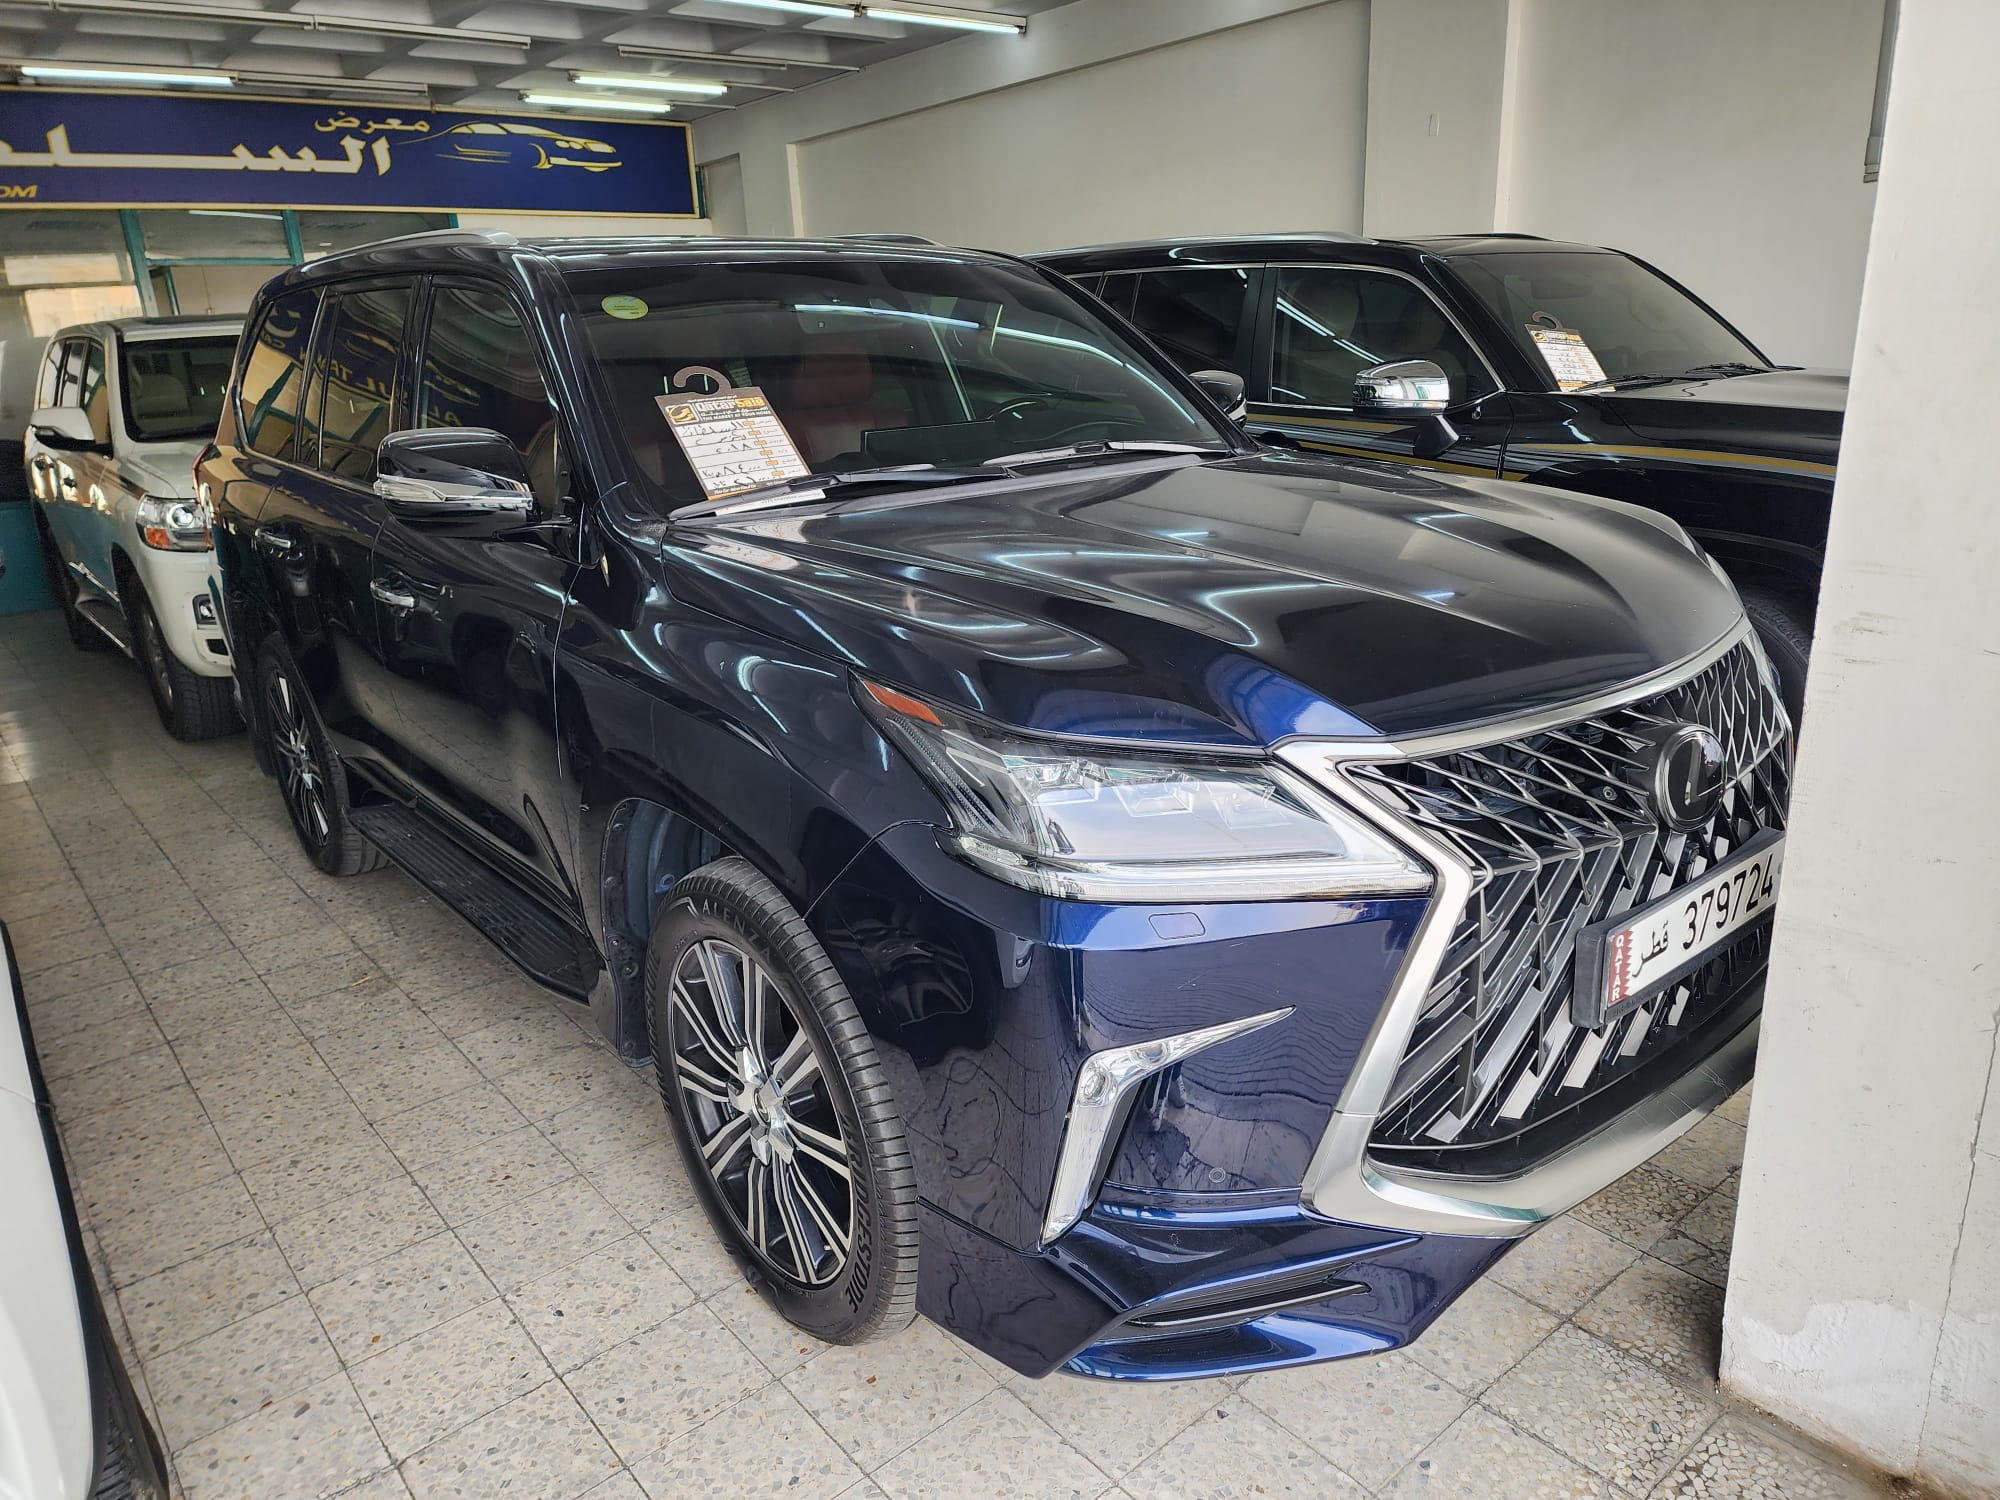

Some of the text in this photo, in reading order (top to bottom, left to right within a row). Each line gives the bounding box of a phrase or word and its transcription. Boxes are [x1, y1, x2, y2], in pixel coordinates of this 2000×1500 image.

[314, 110, 430, 134] معرض
[695, 397, 766, 412] QatarSale
[702, 898, 771, 962] ALENZA
[1681, 853, 1773, 951] 379724
[1610, 935, 1625, 1002] QATAR
[1632, 919, 1670, 978] قطر
